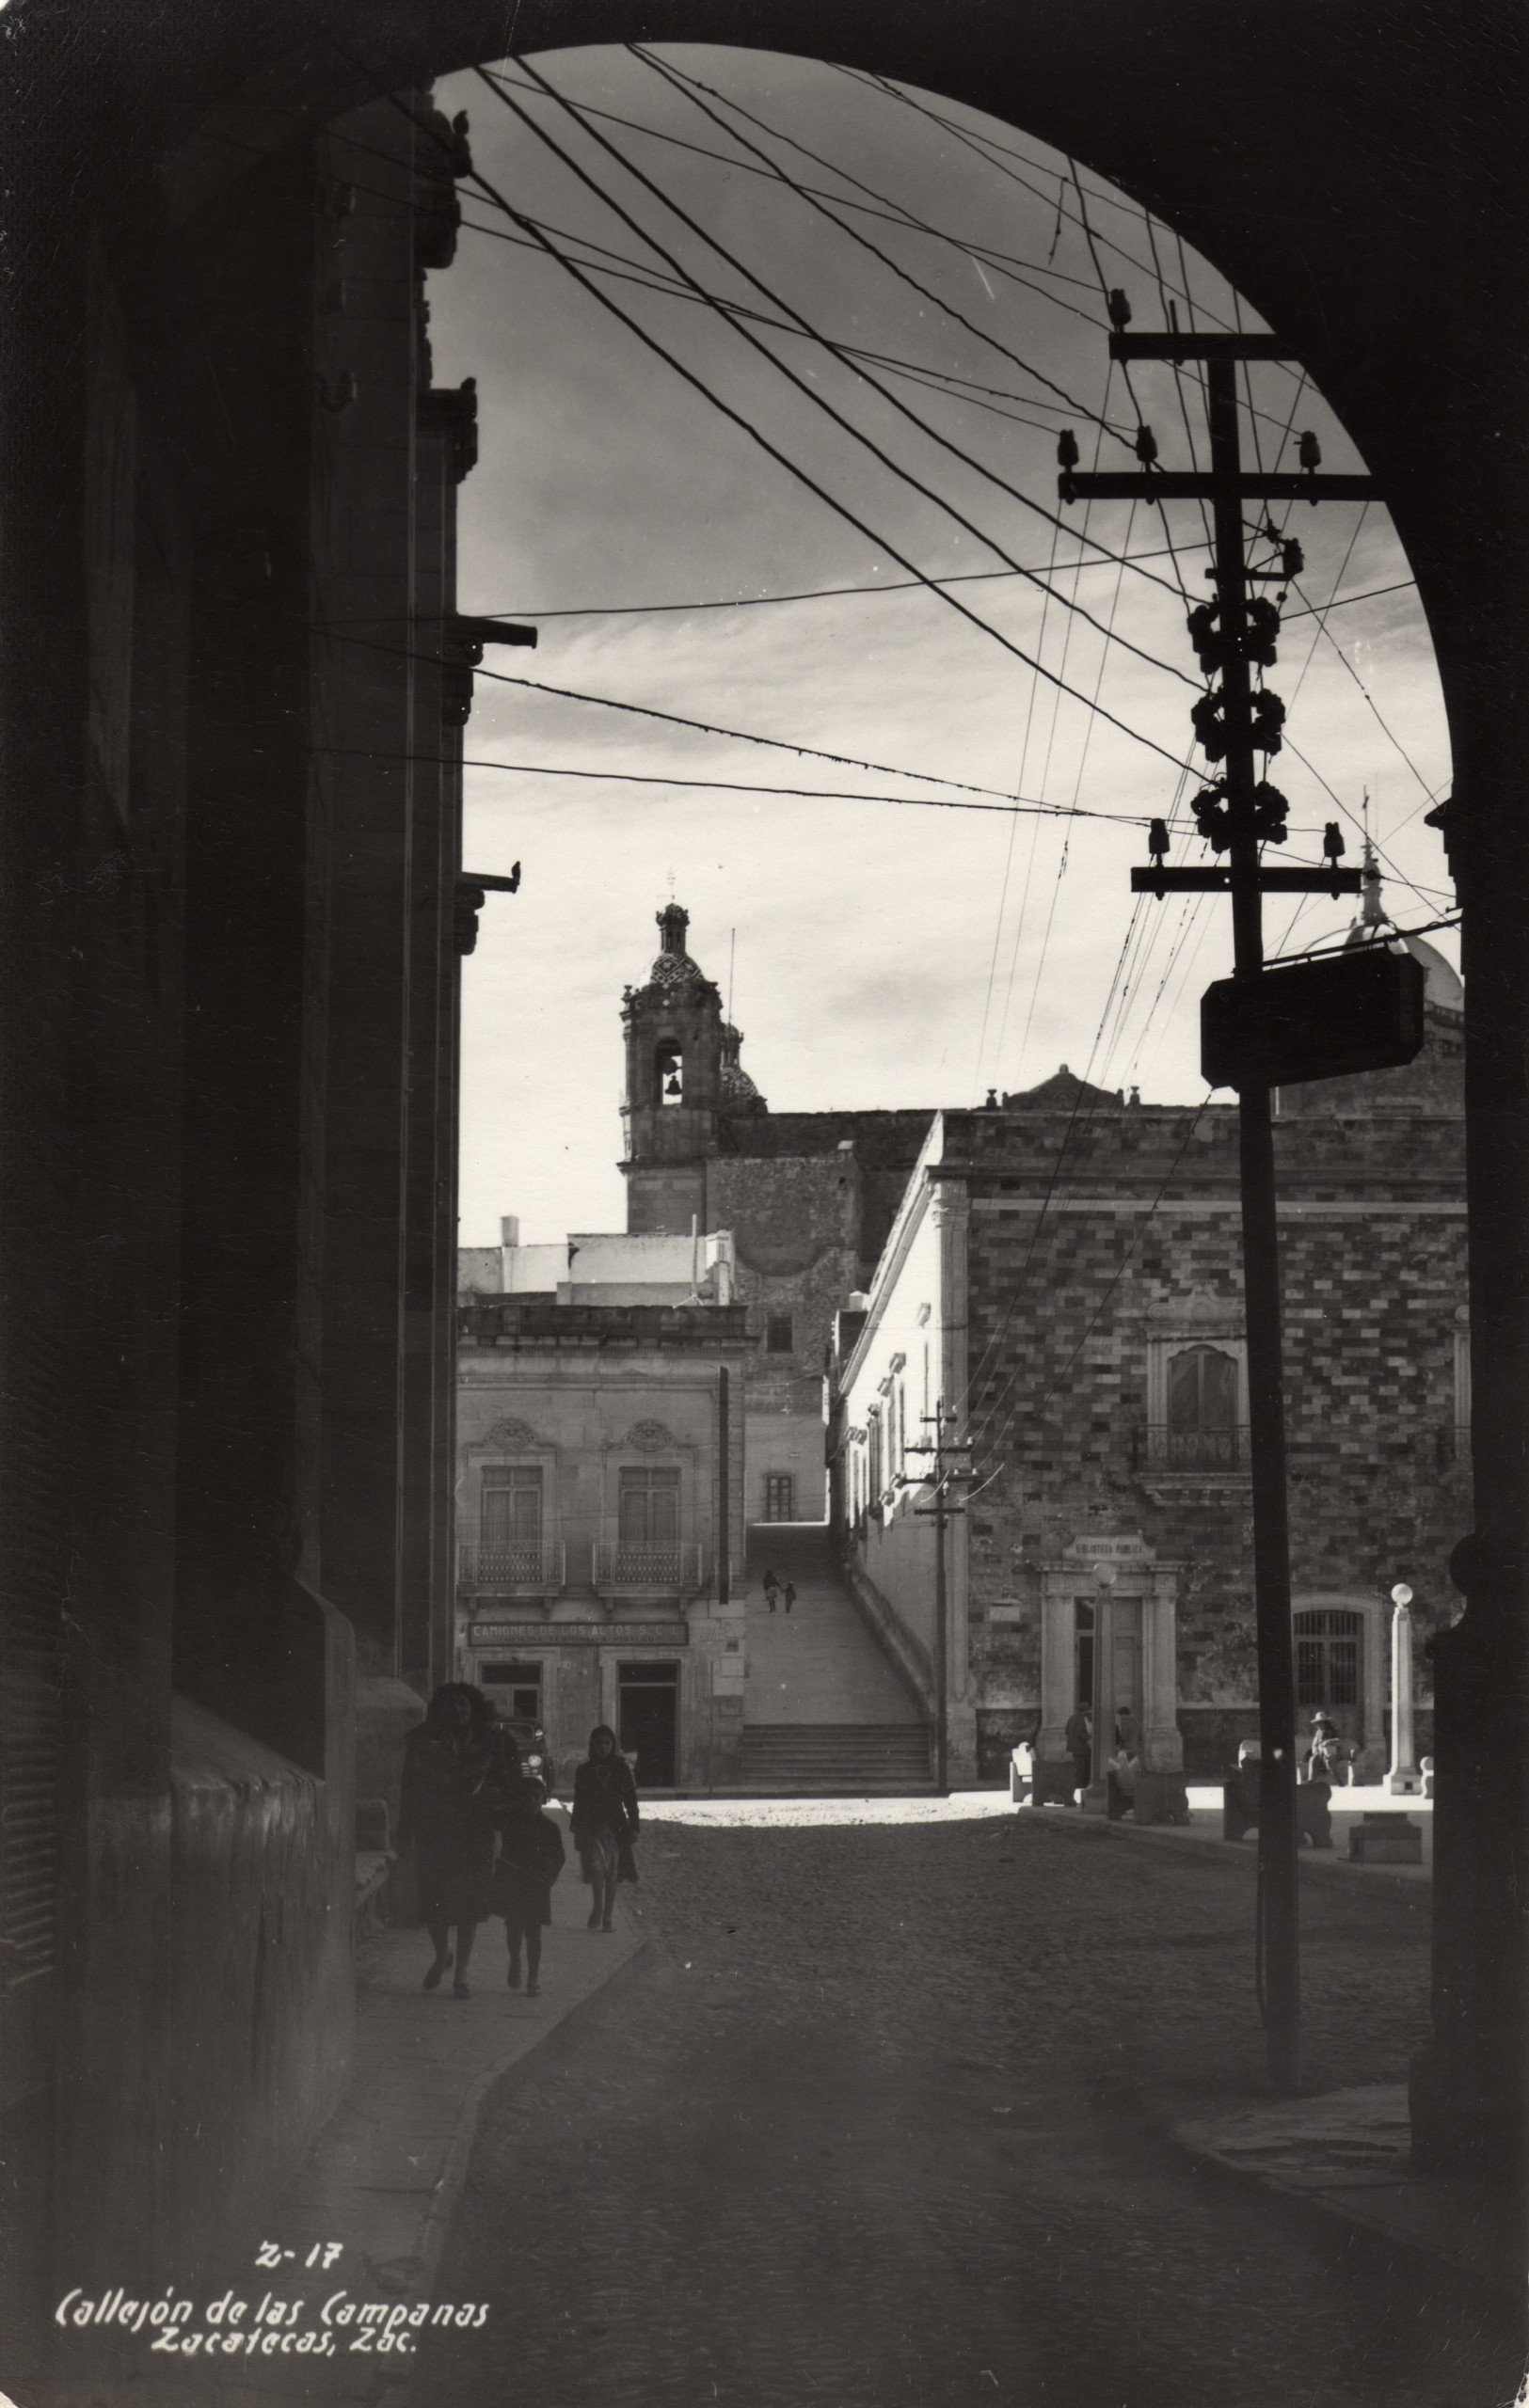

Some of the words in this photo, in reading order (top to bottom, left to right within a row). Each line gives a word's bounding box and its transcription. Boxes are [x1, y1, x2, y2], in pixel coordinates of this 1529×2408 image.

[473, 1624, 534, 1637] CAMIONES
[539, 1624, 555, 1636] DE
[561, 1624, 585, 1636] LOS
